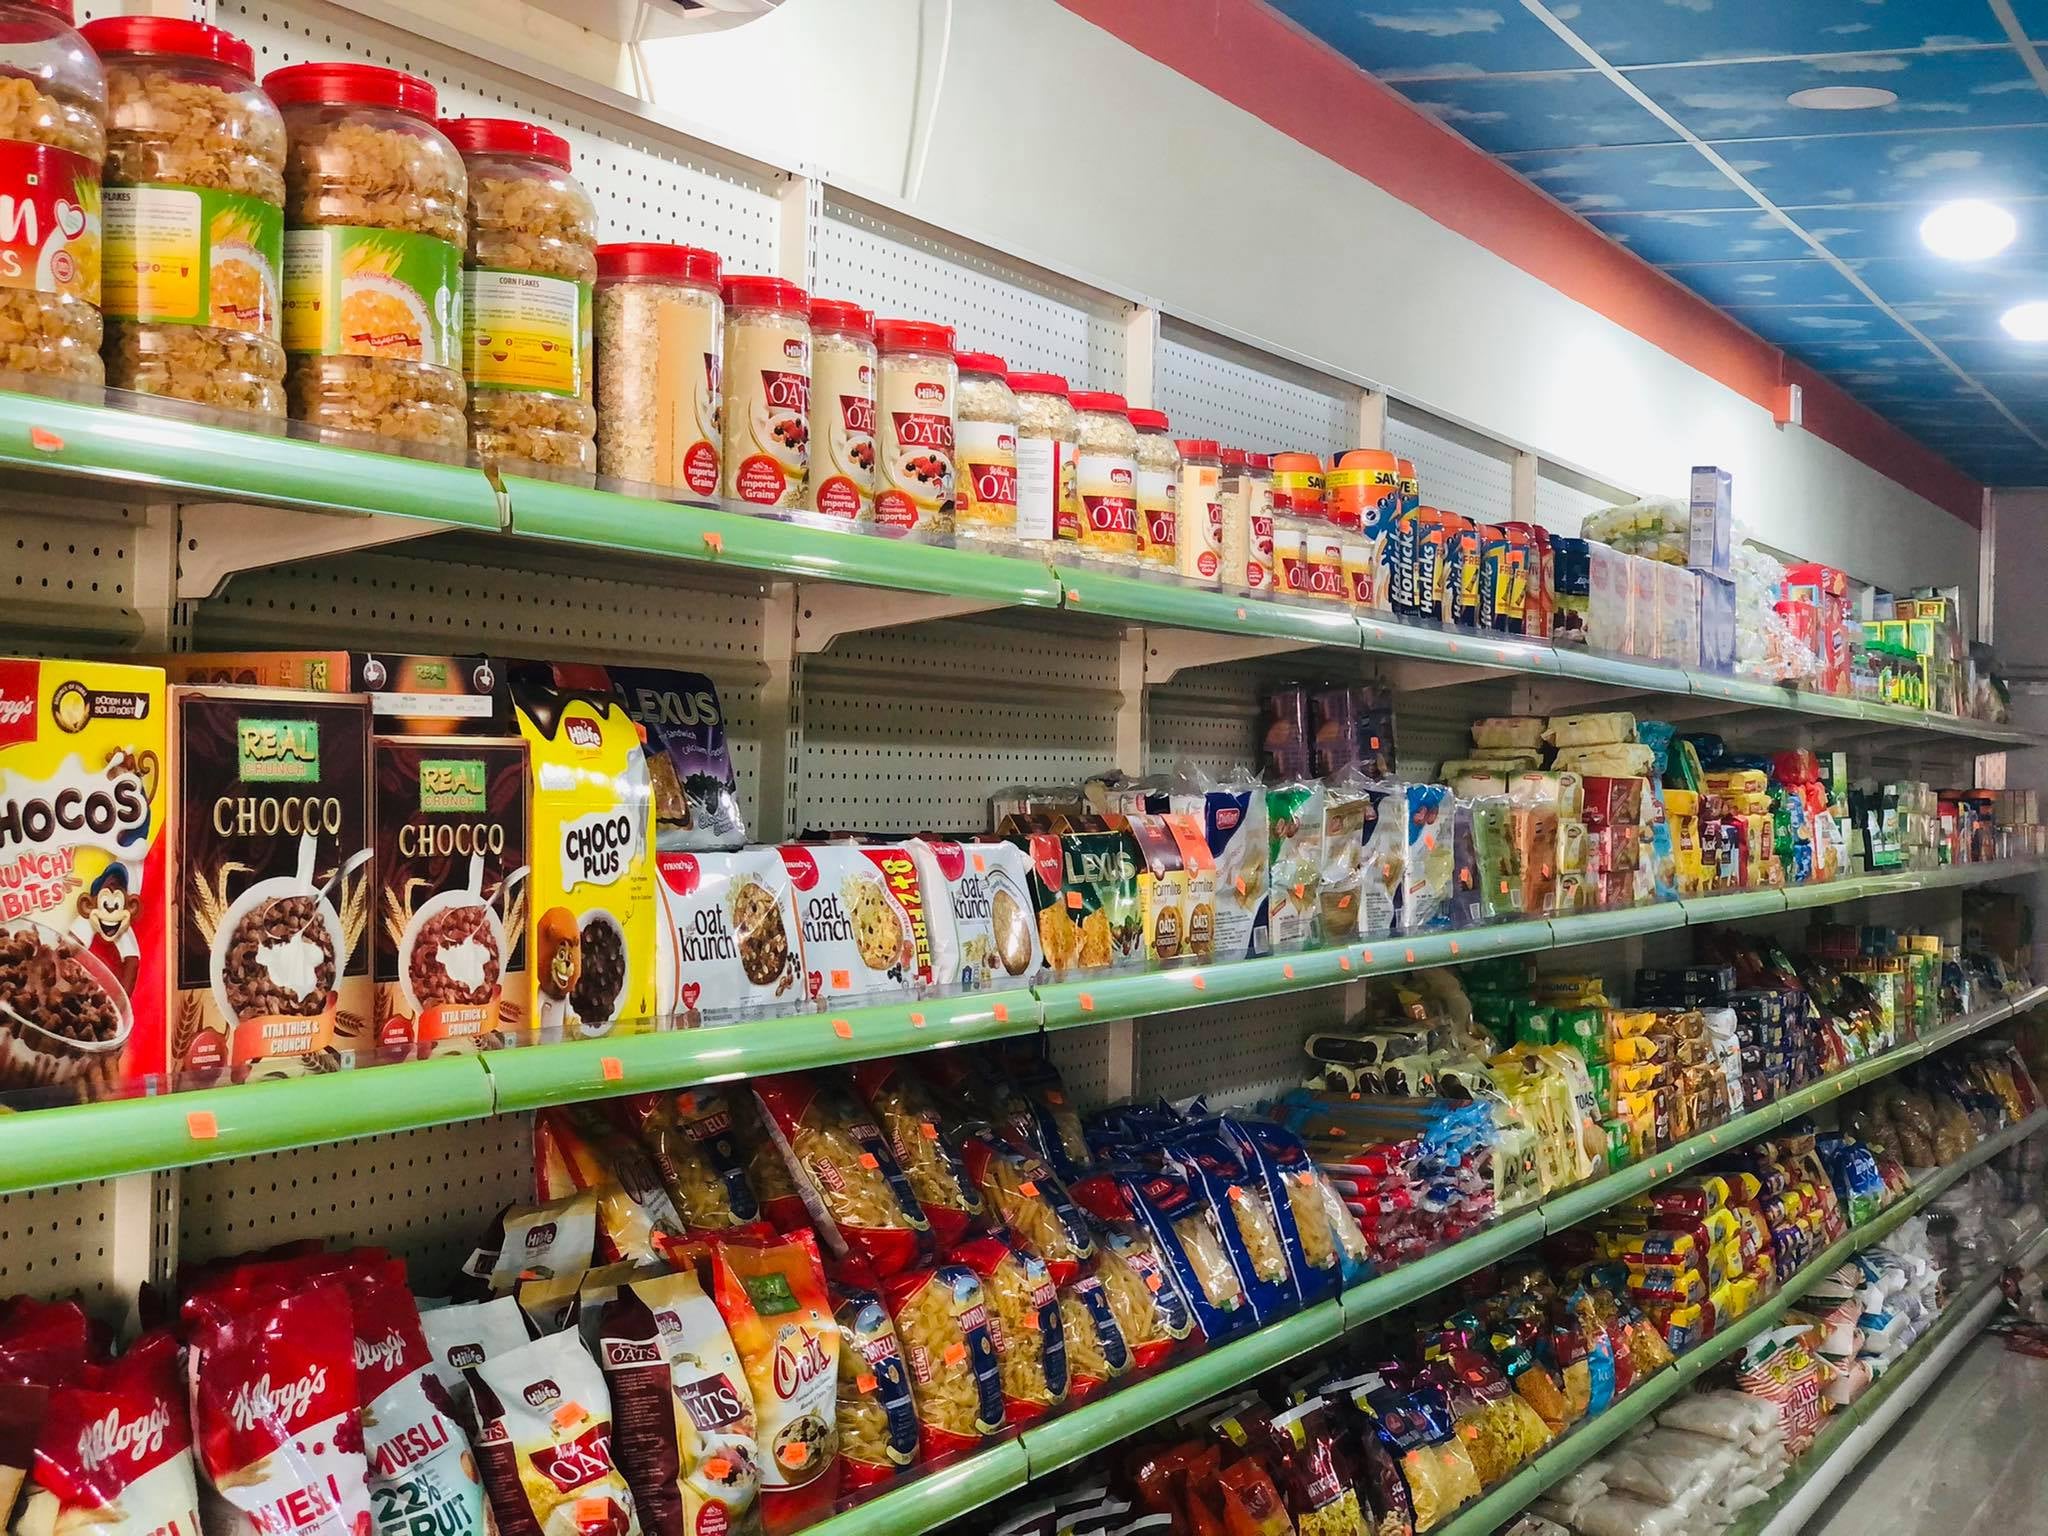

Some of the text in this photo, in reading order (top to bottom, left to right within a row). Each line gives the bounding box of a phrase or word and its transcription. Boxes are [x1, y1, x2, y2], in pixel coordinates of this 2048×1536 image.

[499, 276, 540, 289] CORN FLAKES
[900, 423, 952, 447] OATS
[688, 466, 717, 478] Imported
[691, 477, 714, 488] Grains
[741, 479, 780, 490] Imported
[746, 472, 775, 481] Premium
[745, 488, 775, 499] Grains
[822, 499, 856, 510] Imported
[826, 492, 852, 500] Premium
[876, 512, 912, 522] mported
[1420, 545, 1434, 614] Horlicks
[121, 697, 133, 706] KA
[242, 727, 315, 762] REAL
[422, 767, 483, 795] REAL
[213, 796, 342, 838] CHOCCO
[399, 823, 504, 858] CHOCCO
[566, 815, 631, 861] CHOCO
[583, 850, 620, 878] PLUS
[1064, 851, 1136, 885] LEXUS
[961, 873, 982, 899] oat
[809, 892, 843, 921] oat
[952, 890, 992, 920] krunch
[695, 903, 723, 936] oat
[1158, 919, 1176, 934] OATS
[1193, 914, 1209, 928] OATS
[679, 924, 737, 962] krunch
[907, 908, 932, 967] FREE
[819, 1158, 845, 1191] DIVELLA
[452, 1350, 484, 1367] Hilife
[611, 1347, 657, 1363] OATS
[773, 1326, 831, 1400] Oats
[913, 1349, 929, 1383] DIVELLA
[232, 1364, 328, 1432] Kellogg's
[527, 1386, 559, 1406] Hilife
[77, 1397, 170, 1472] Kellogg's
[550, 1434, 612, 1484] OAT
[371, 1473, 442, 1524] 22%
